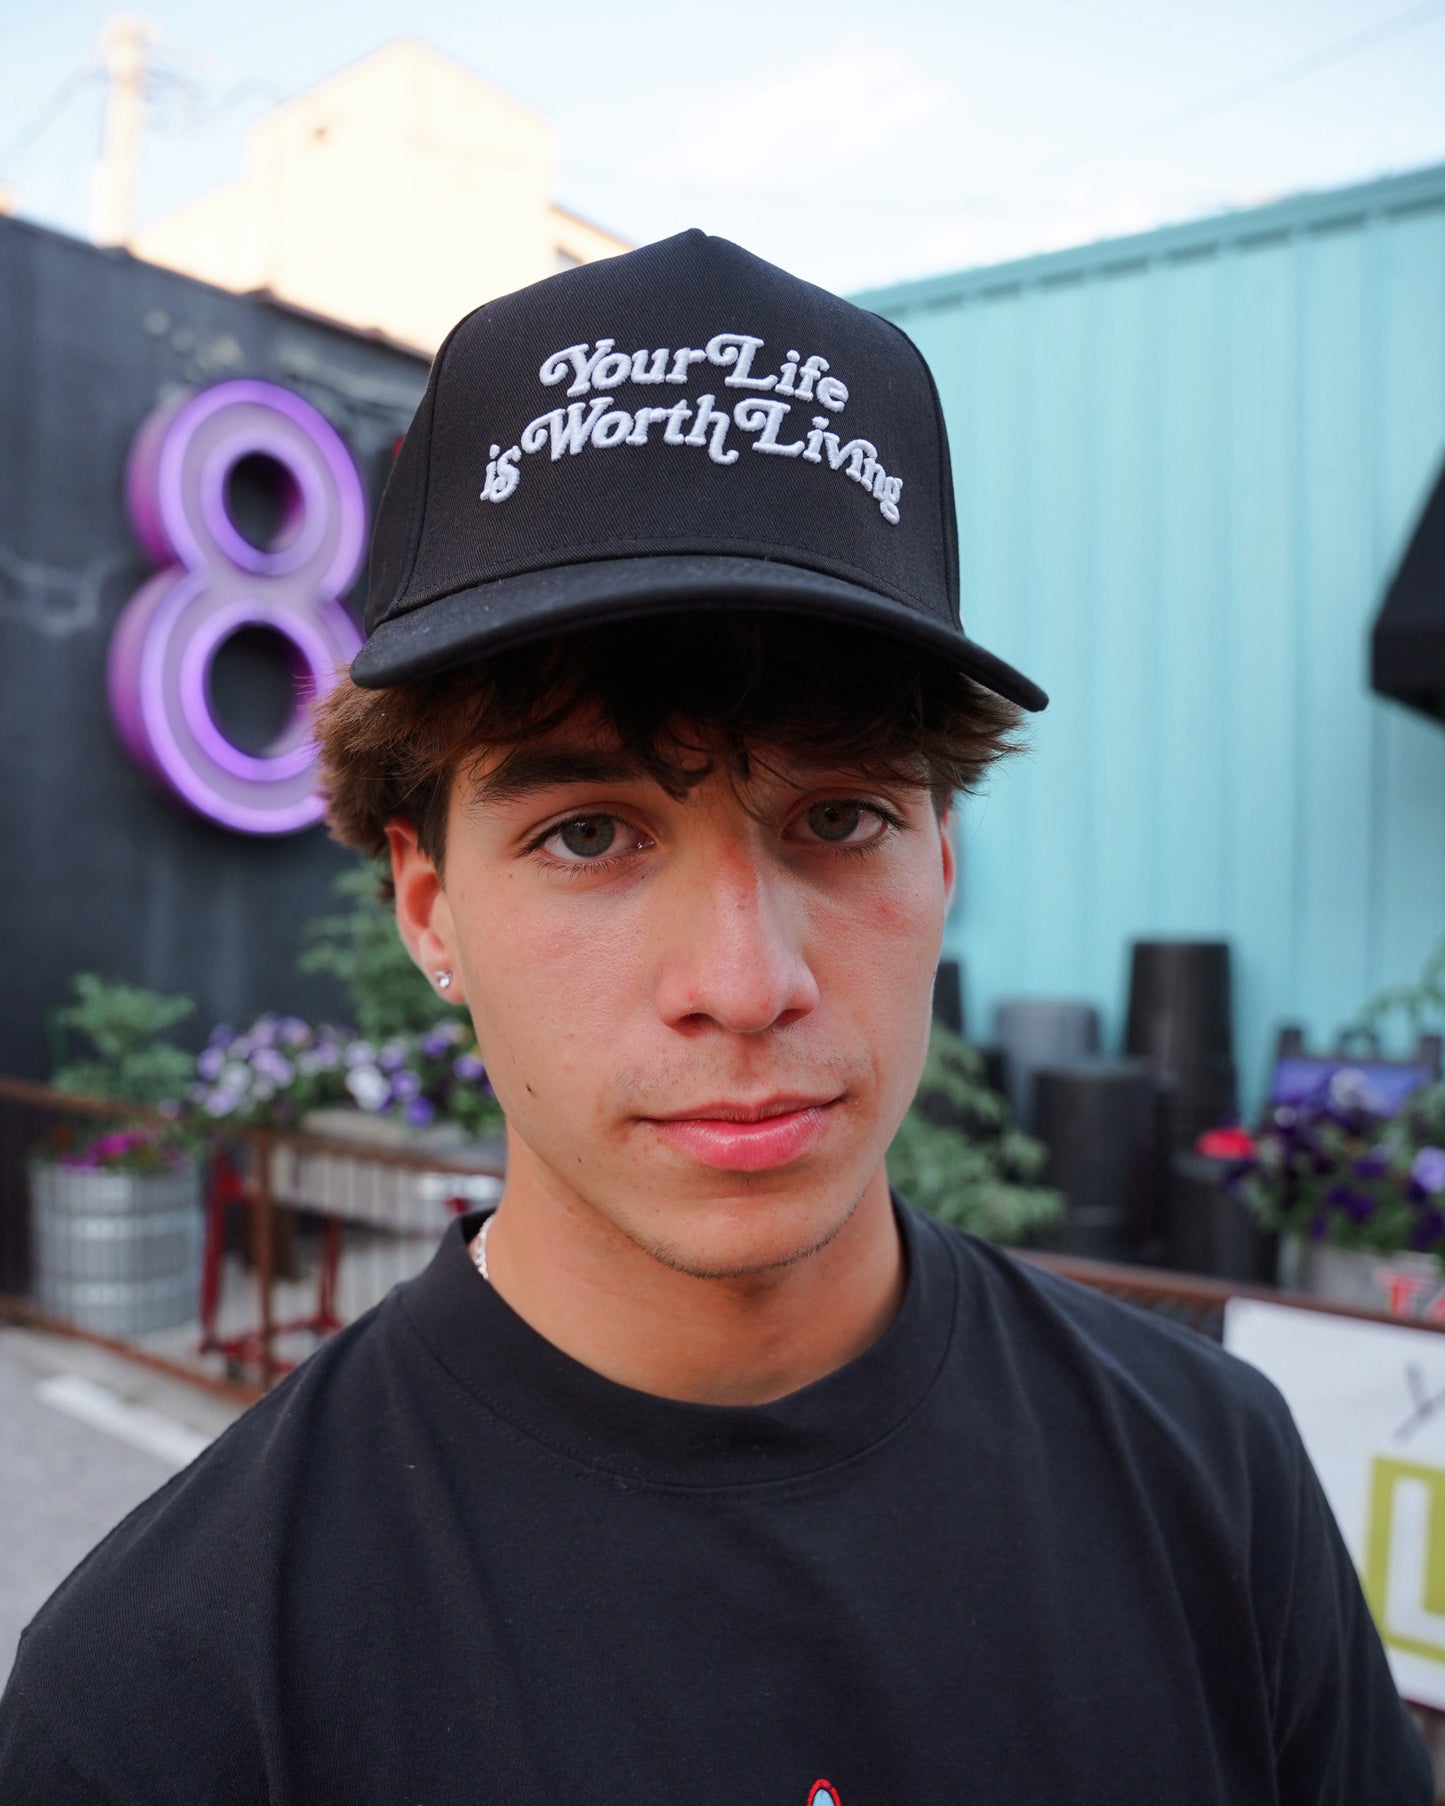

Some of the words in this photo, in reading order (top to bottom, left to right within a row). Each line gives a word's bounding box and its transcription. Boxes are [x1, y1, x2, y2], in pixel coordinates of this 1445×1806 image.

[539, 338, 706, 397] Your
[706, 333, 849, 412] Life
[480, 444, 521, 503] is
[521, 394, 739, 465] Worth
[734, 398, 903, 525] Living
[110, 379, 367, 834] 8
